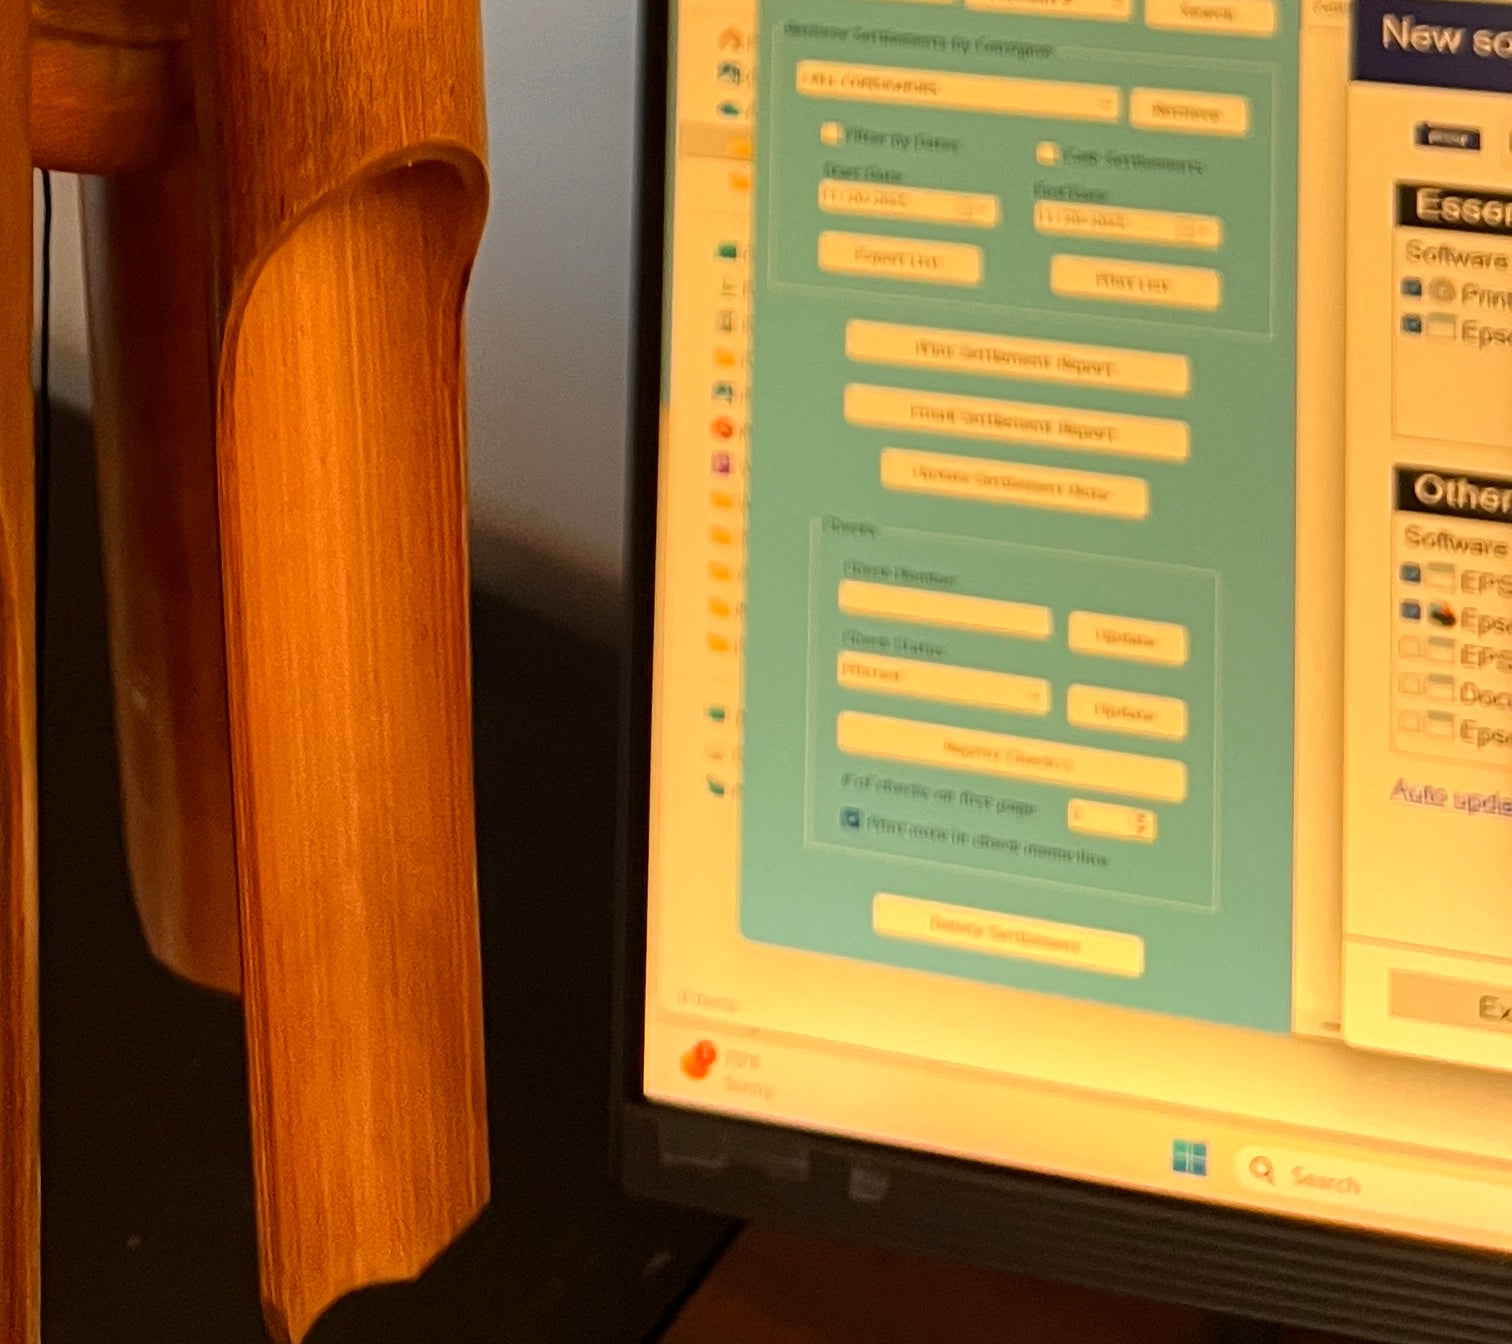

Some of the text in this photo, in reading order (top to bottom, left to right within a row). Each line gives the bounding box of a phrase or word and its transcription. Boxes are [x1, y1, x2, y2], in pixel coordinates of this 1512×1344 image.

[1382, 13, 1467, 55] New
[1405, 238, 1509, 270] Software
[1414, 473, 1512, 514] Other
[1404, 524, 1508, 559] Software
[1291, 1165, 1362, 1196] Search
